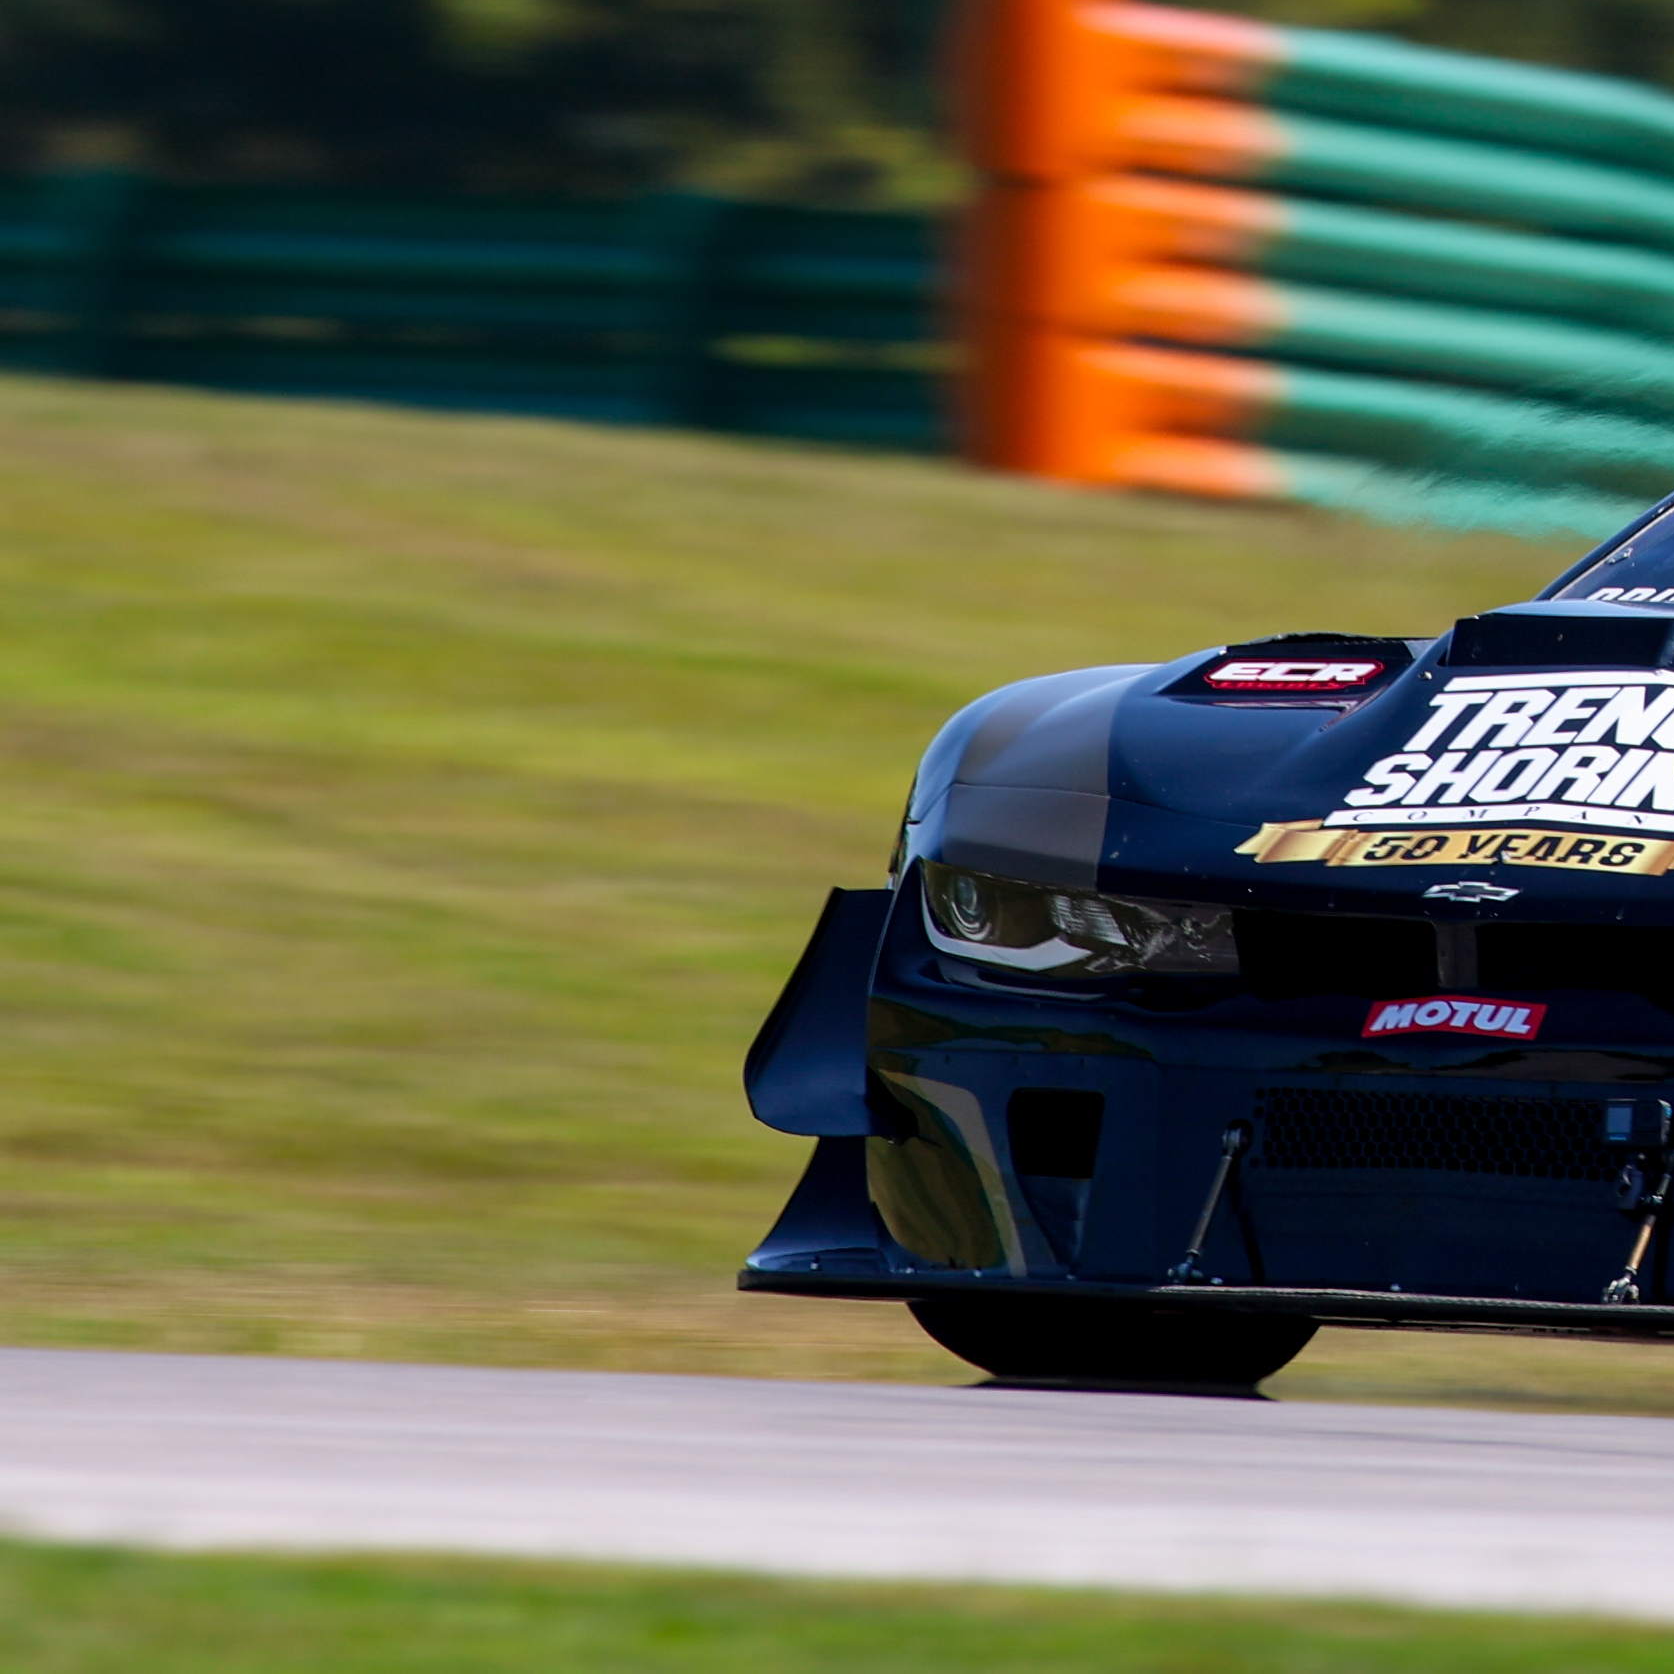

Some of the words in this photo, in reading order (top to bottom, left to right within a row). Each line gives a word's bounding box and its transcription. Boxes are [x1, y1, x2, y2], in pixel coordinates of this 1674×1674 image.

[1209, 662, 1377, 681] ECR
[1363, 836, 1450, 861] 50
[1457, 834, 1646, 867] YEARS
[1369, 1000, 1532, 1034] MOTUL
